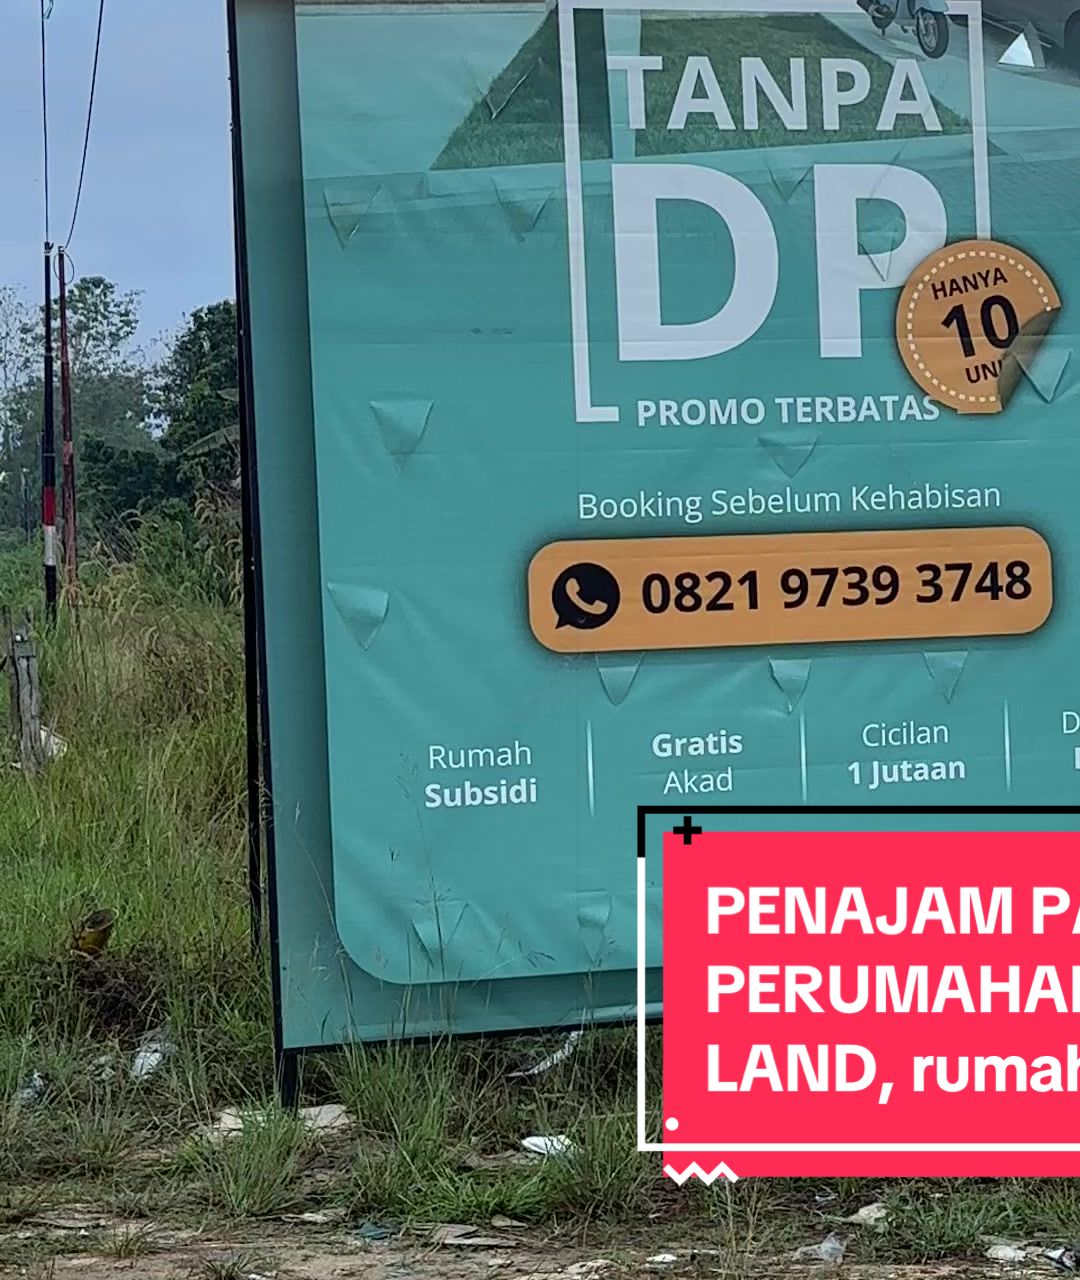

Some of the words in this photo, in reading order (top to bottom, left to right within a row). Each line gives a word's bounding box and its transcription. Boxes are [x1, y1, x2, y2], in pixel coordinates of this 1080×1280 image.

[607, 55, 943, 132] TANPA
[610, 163, 948, 361] DP
[931, 267, 1008, 300] HANYA
[941, 294, 1019, 358] 10
[637, 397, 766, 427] PROMO
[774, 394, 940, 424] TERBATAS
[578, 491, 703, 524] Booking
[711, 488, 841, 517] Sebelum
[851, 483, 1002, 512] Kehabisan
[641, 569, 759, 615] 0821
[780, 565, 900, 609] 9739
[915, 560, 1033, 604] 3748
[651, 729, 744, 758] Gratis
[861, 720, 949, 747] Cicilan
[428, 740, 532, 769] Rumah
[662, 767, 734, 795] Akad
[847, 762, 861, 785] 1
[869, 759, 966, 790] Jutaan
[424, 778, 538, 809] Subsidi
